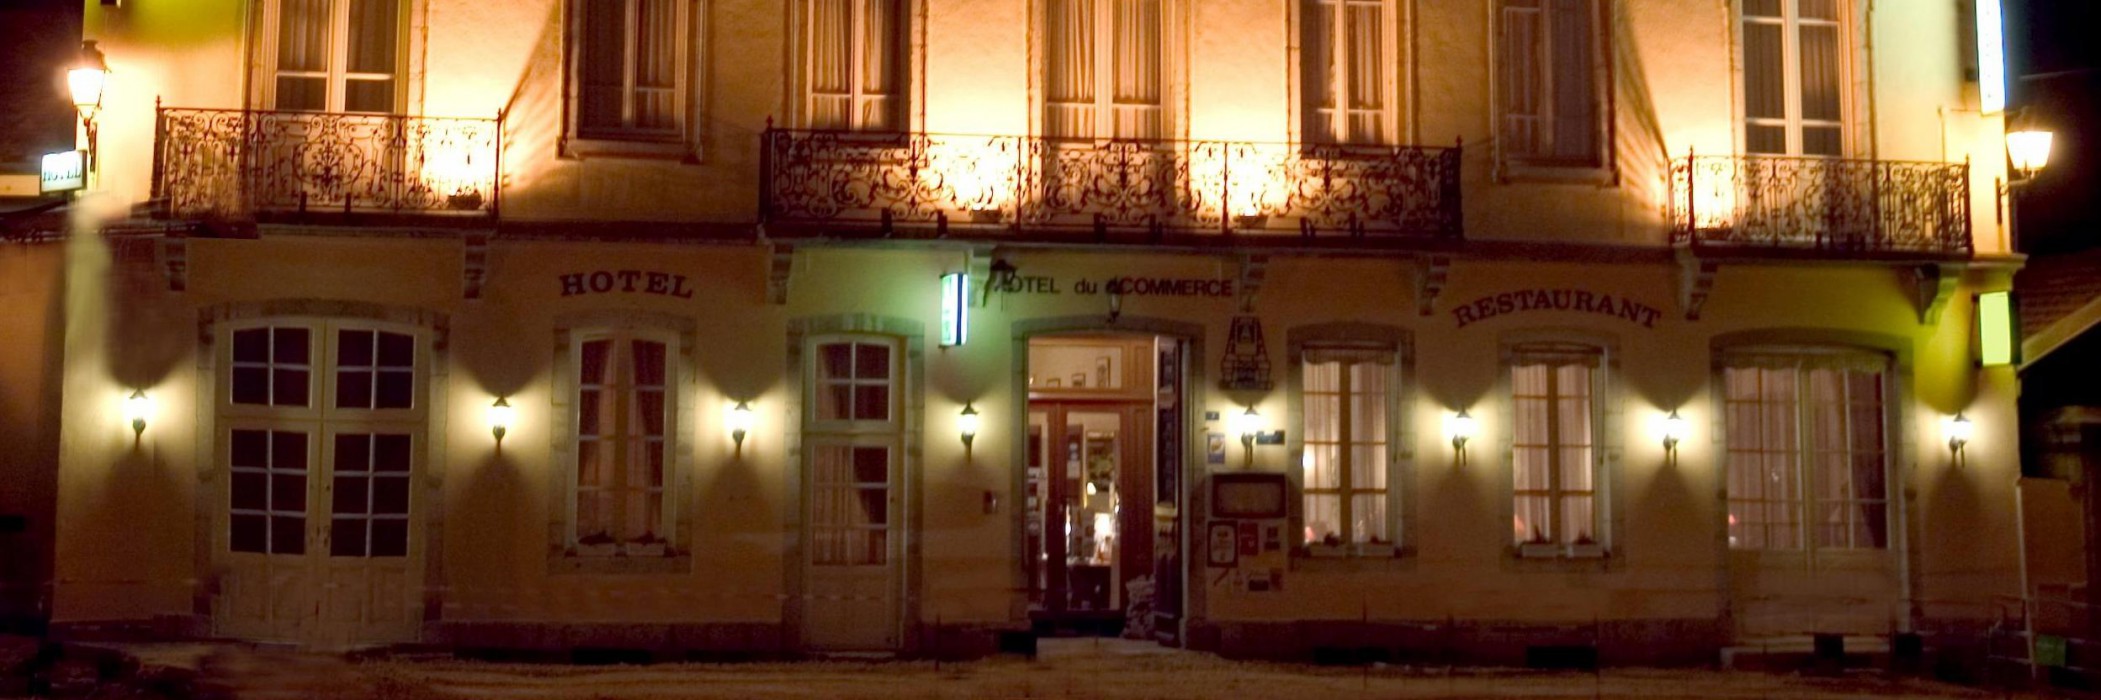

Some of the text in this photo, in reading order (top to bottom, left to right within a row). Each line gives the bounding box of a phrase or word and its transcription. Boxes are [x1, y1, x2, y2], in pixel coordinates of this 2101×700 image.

[559, 270, 693, 299] HOTEL
[1075, 277, 1097, 293] du
[1117, 277, 1233, 296] COMMERCE
[1452, 288, 1662, 329] RESTAURANT
